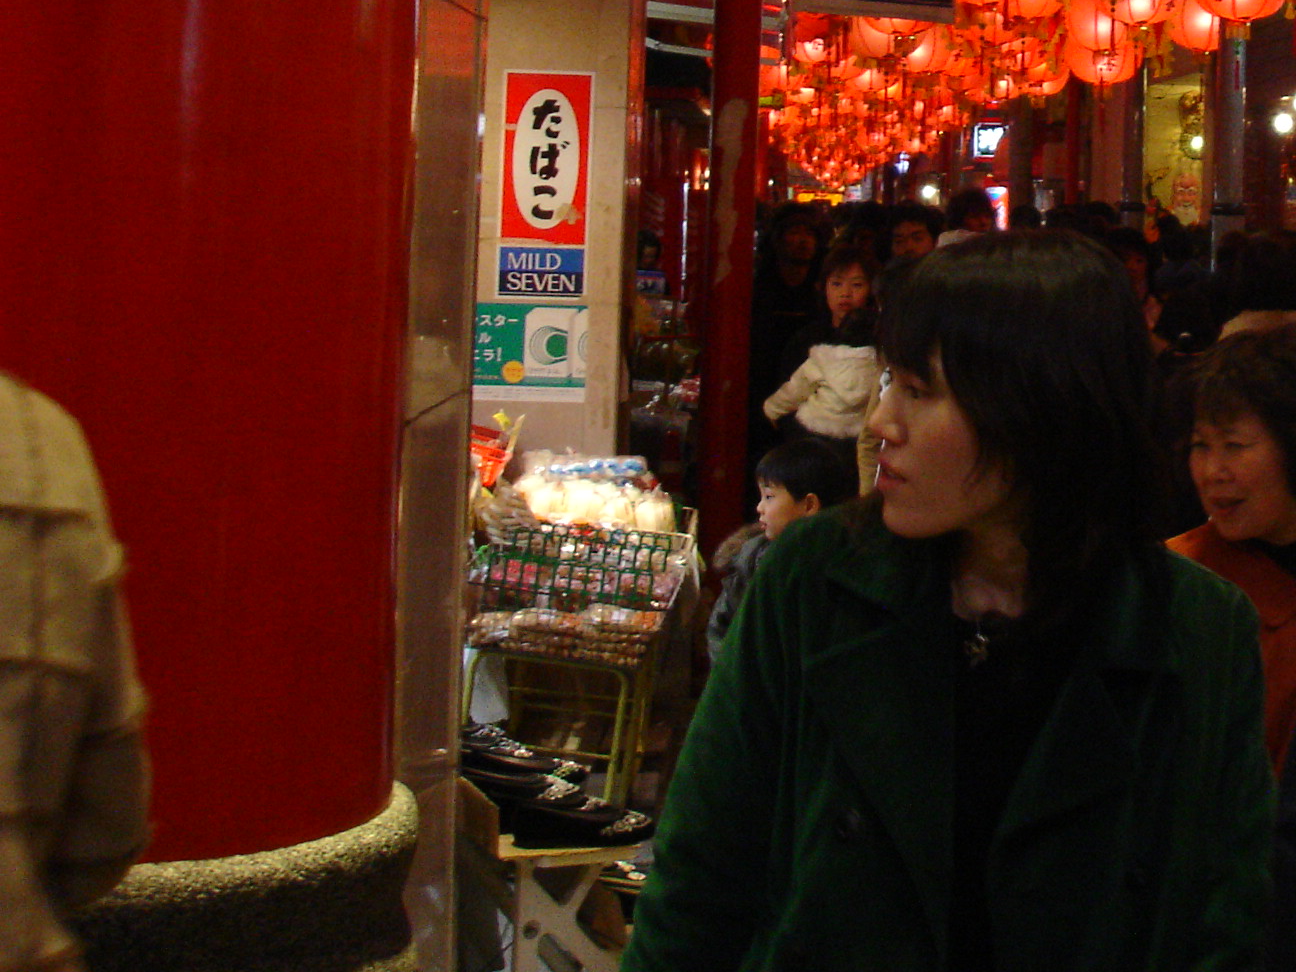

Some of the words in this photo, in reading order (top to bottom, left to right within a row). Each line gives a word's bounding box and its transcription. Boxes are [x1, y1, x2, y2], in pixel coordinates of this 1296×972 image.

[528, 98, 571, 221] たばこ
[506, 251, 562, 271] MILD
[506, 272, 577, 293] SEVEN
[475, 314, 519, 327] スター
